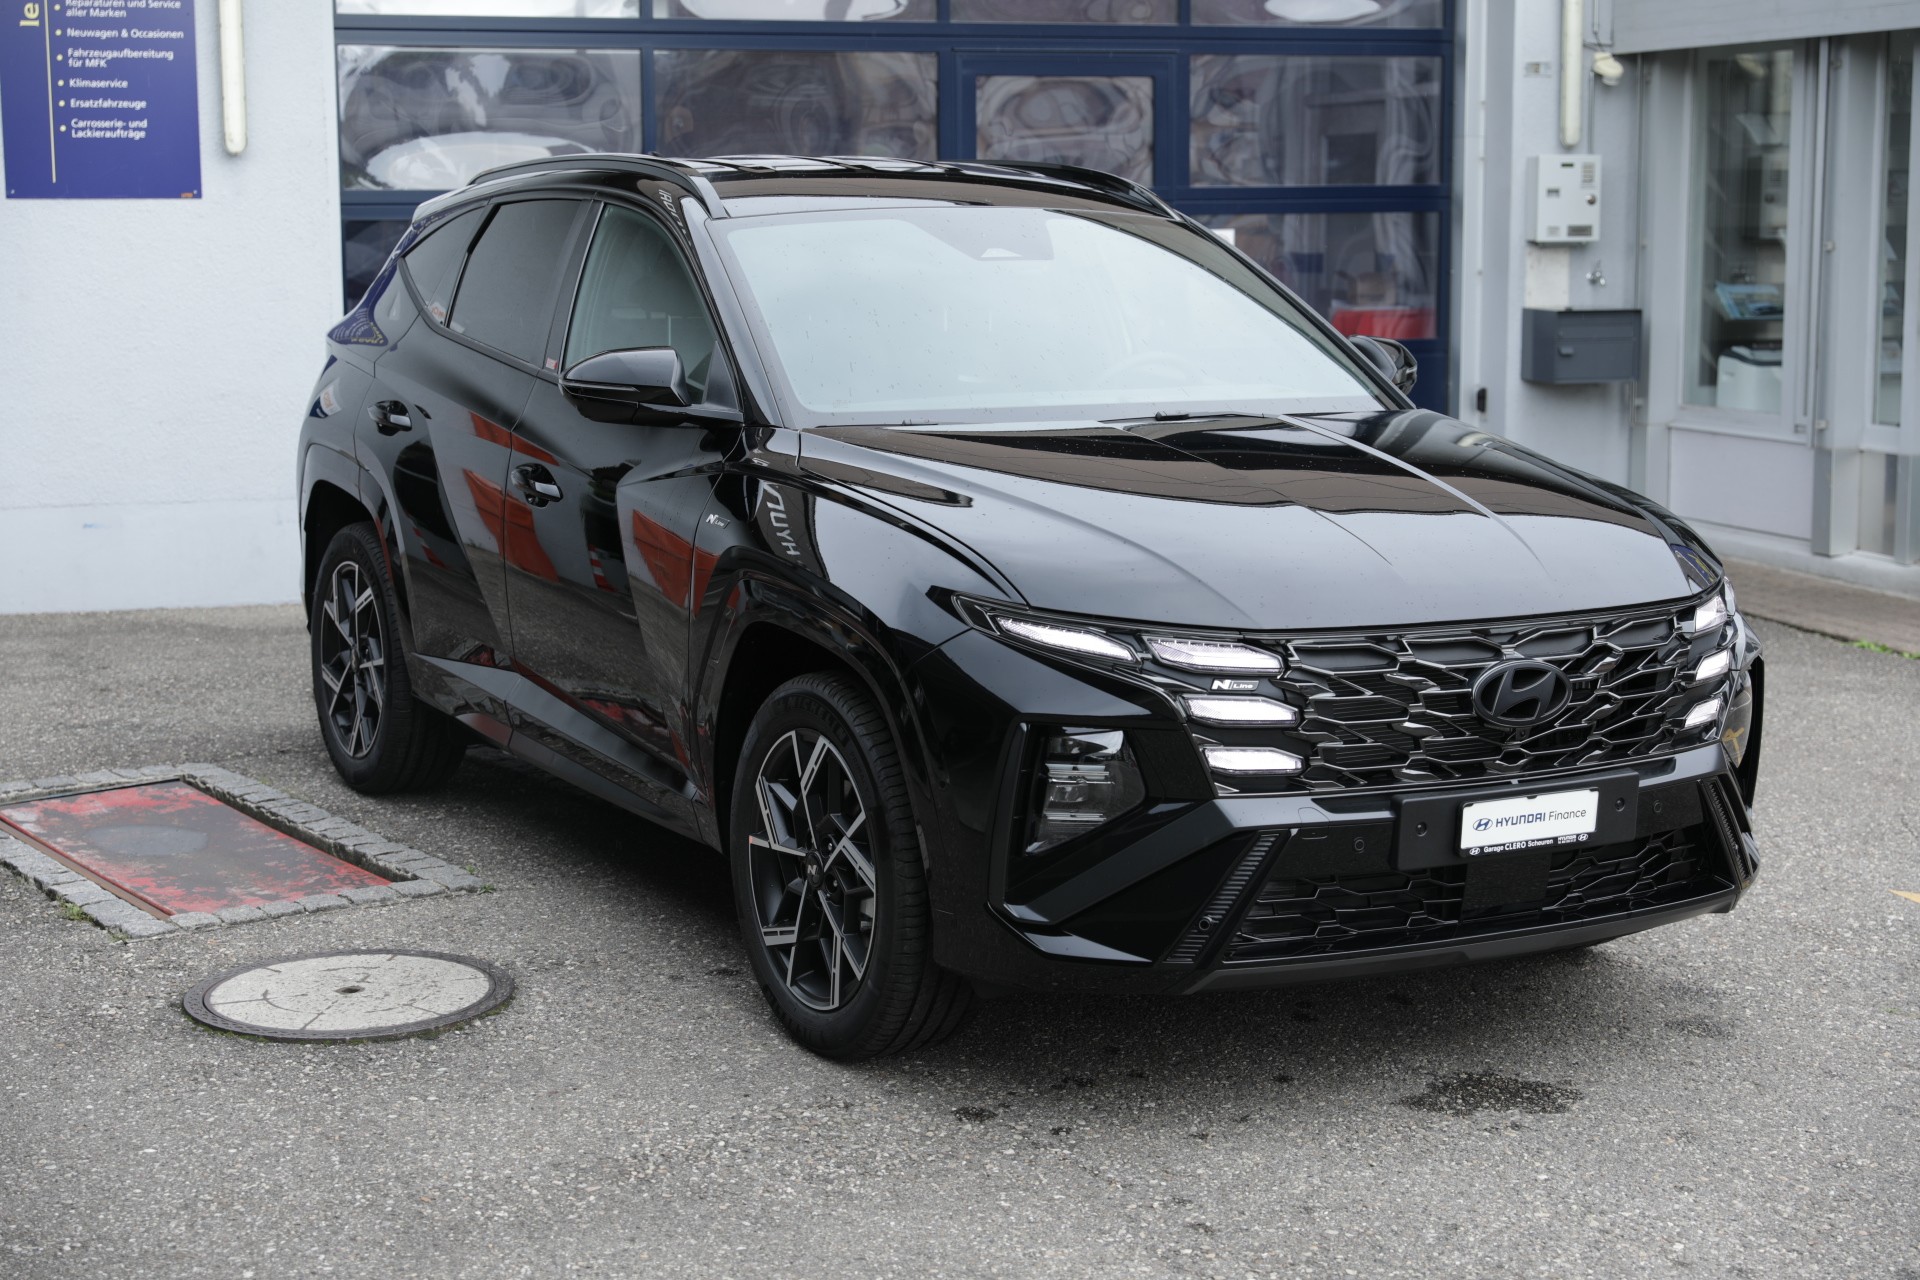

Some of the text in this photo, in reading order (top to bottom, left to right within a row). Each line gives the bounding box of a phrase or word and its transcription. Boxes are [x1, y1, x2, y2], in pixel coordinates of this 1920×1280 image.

[65, 0, 181, 9] Reparaturen und Service
[19, 2, 40, 27] le
[66, 8, 126, 18] aller Marken
[67, 28, 184, 39] Neuwagen & Occasionen
[67, 48, 174, 60] Fahrzeugaufbereitung
[68, 58, 107, 68] für MFK
[69, 78, 128, 89] Klimaservice
[70, 98, 147, 110] Ersatzfahrzeuge
[71, 118, 148, 129] Carrosserie- und
[71, 128, 146, 140] Lackieraufträge
[1211, 679, 1231, 690] N
[1495, 809, 1587, 828] HYUNDAI Finance
[1483, 844, 1504, 854] Garage
[1504, 841, 1527, 851] CLERO
[1527, 838, 1554, 848] Scheuren
